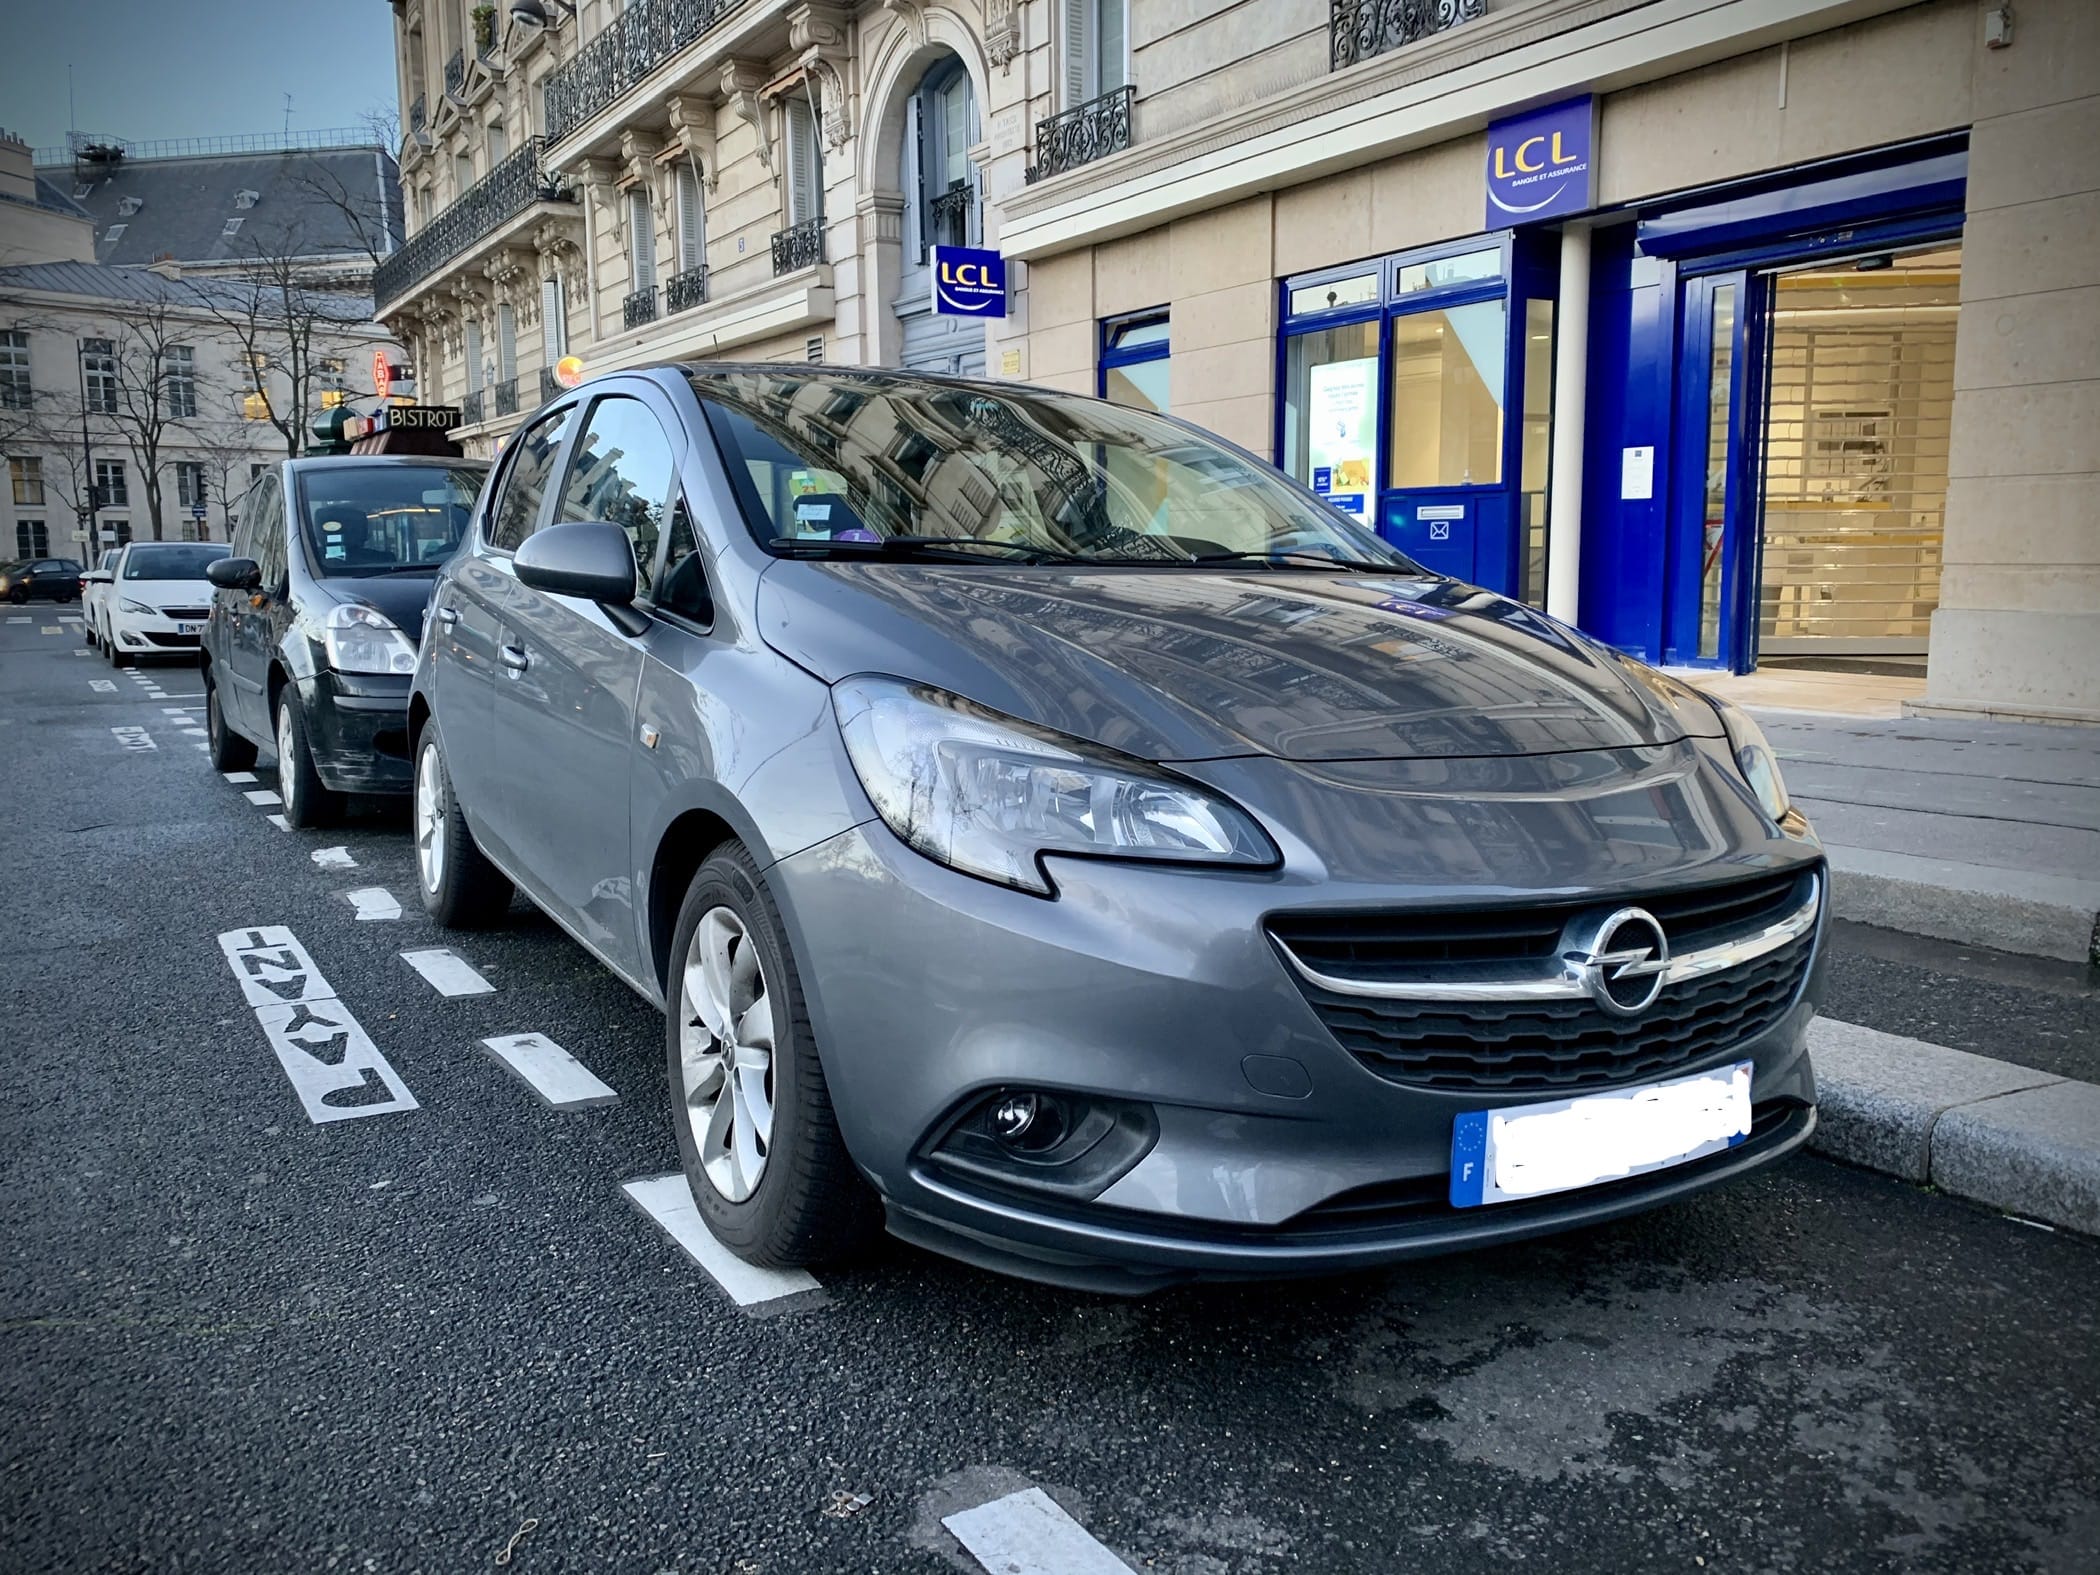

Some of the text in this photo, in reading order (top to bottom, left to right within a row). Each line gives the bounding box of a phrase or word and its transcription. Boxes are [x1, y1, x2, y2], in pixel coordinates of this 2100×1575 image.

[1495, 131, 1577, 179] LCL
[1512, 163, 1587, 188] BANQUE ET ASSURANCE
[941, 262, 998, 288] LCL
[390, 409, 457, 428] BISTROT
[236, 931, 397, 1109] PAYANT
[1462, 1161, 1474, 1182] F
